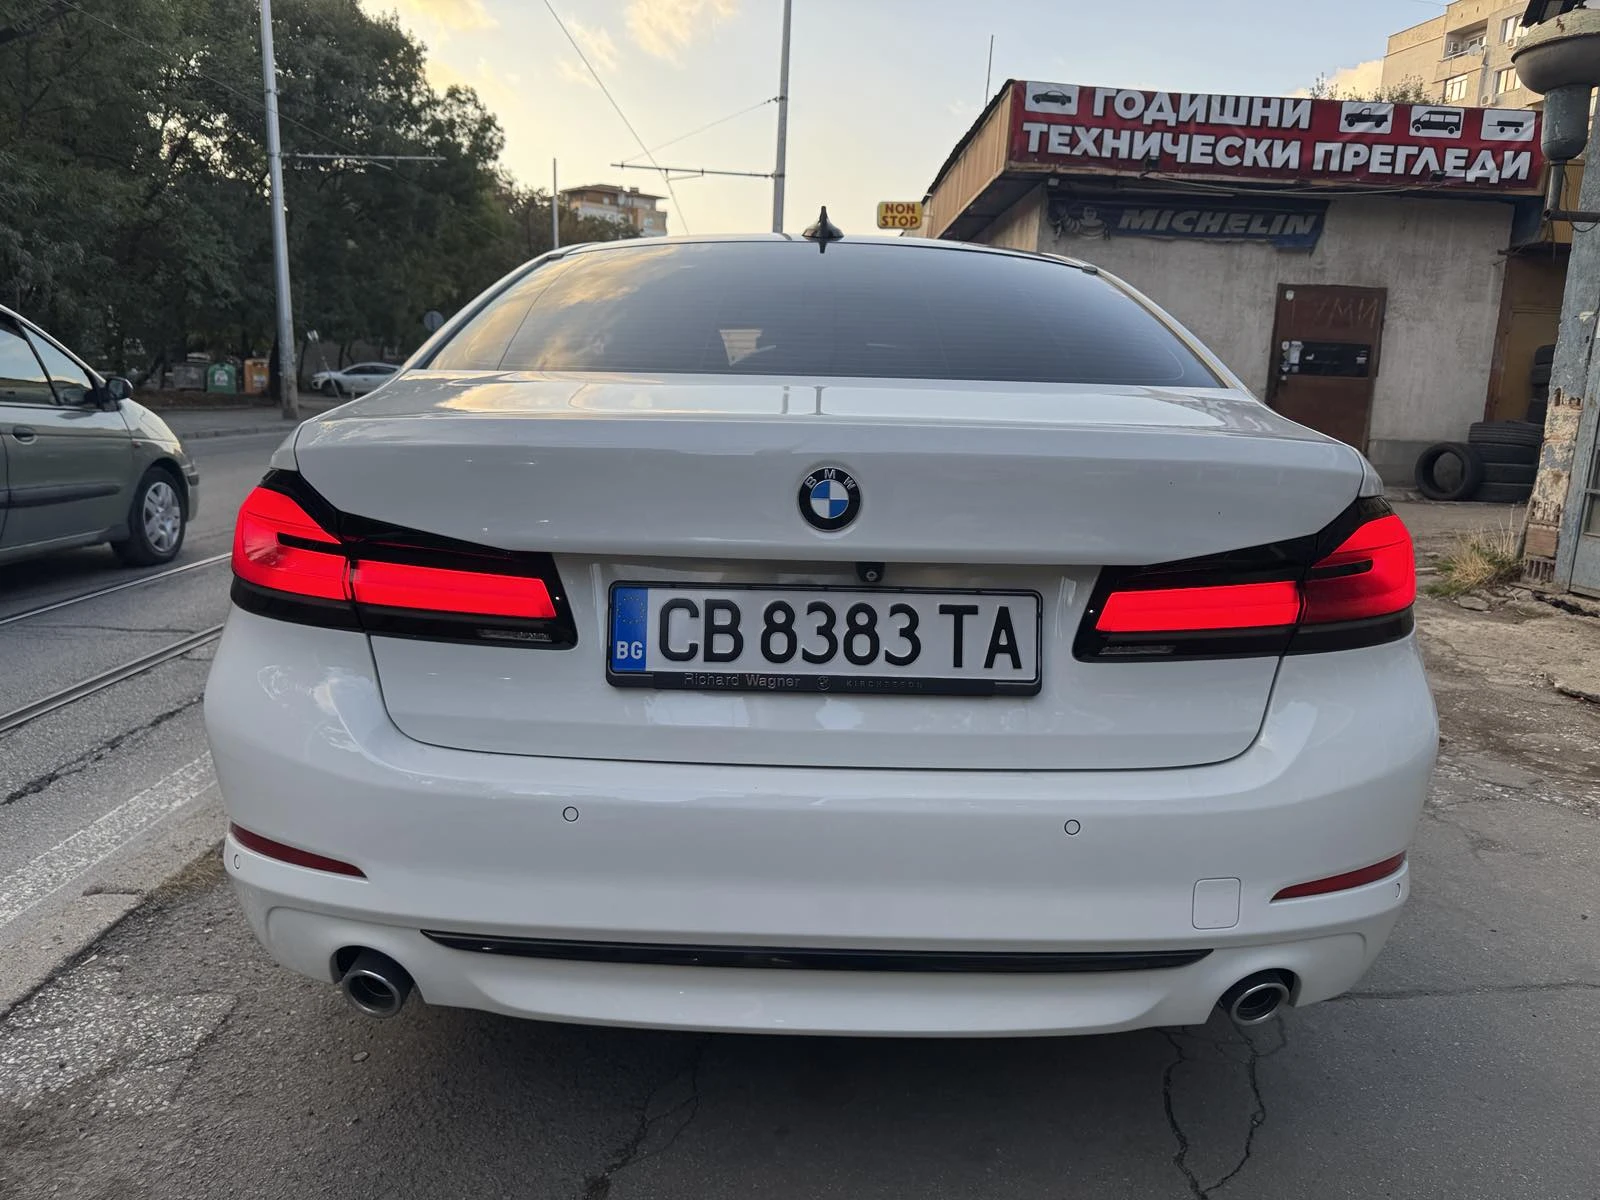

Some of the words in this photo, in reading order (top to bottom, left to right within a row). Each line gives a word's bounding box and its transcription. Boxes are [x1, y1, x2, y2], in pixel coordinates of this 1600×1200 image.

[1092, 86, 1313, 130] ГОДИШНИ
[1022, 122, 1301, 170] ТЕХНИЧЕСКИ
[1312, 142, 1532, 184] ПРЕГЛЕДИ
[885, 203, 916, 214] NON
[882, 215, 918, 227] STOP
[1118, 209, 1319, 235] MICHELIN
[804, 469, 856, 490] BMW
[659, 598, 744, 662] CB
[760, 601, 922, 666] 8383
[939, 604, 1023, 669] TA
[616, 641, 643, 660] BG
[684, 673, 740, 687] Richard
[745, 674, 801, 690] Wagner
